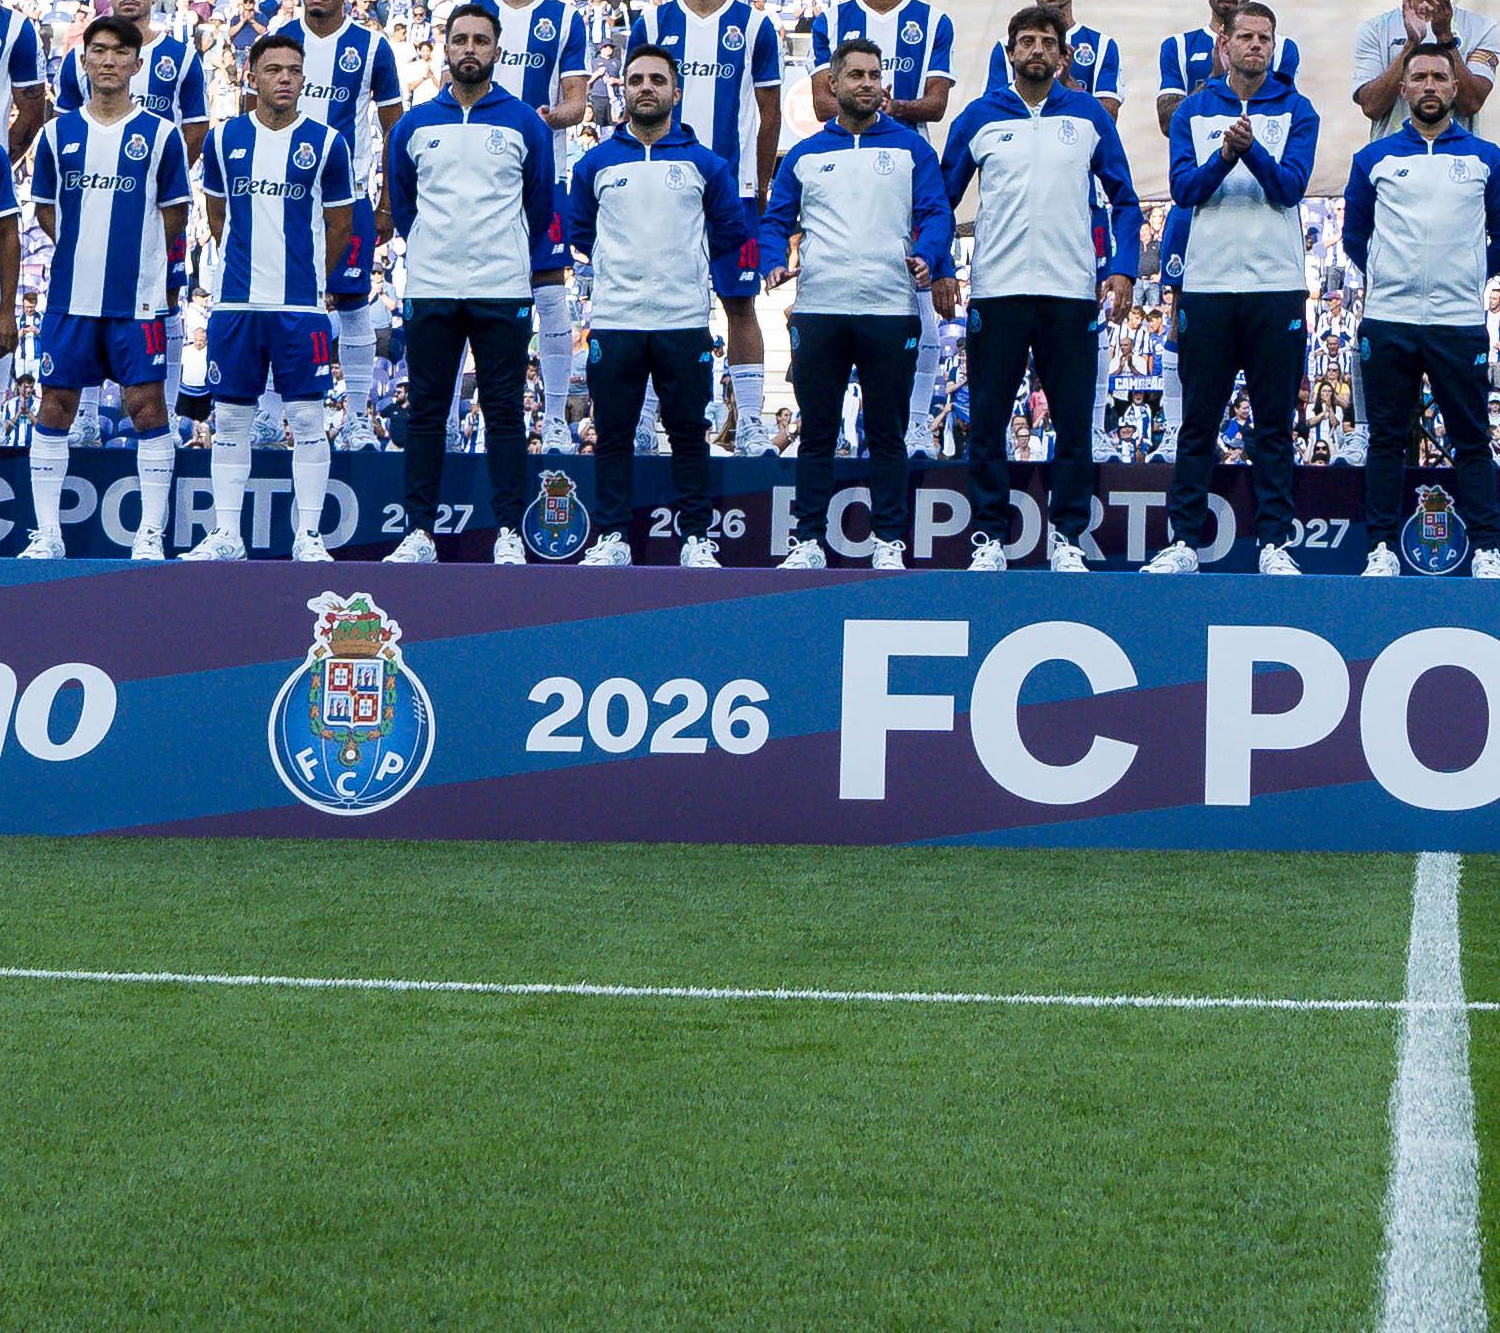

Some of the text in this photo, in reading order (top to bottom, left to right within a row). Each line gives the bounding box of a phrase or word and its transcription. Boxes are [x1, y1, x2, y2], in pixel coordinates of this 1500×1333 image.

[499, 50, 545, 68] tano
[300, 81, 349, 102] tano
[65, 170, 137, 193] Betano
[232, 177, 306, 200] Betano
[310, 330, 330, 364] 11
[382, 503, 474, 535] 227
[649, 507, 746, 539] 226
[525, 675, 771, 756] 2026
[838, 618, 1141, 806] FC
[378, 750, 406, 783] P
